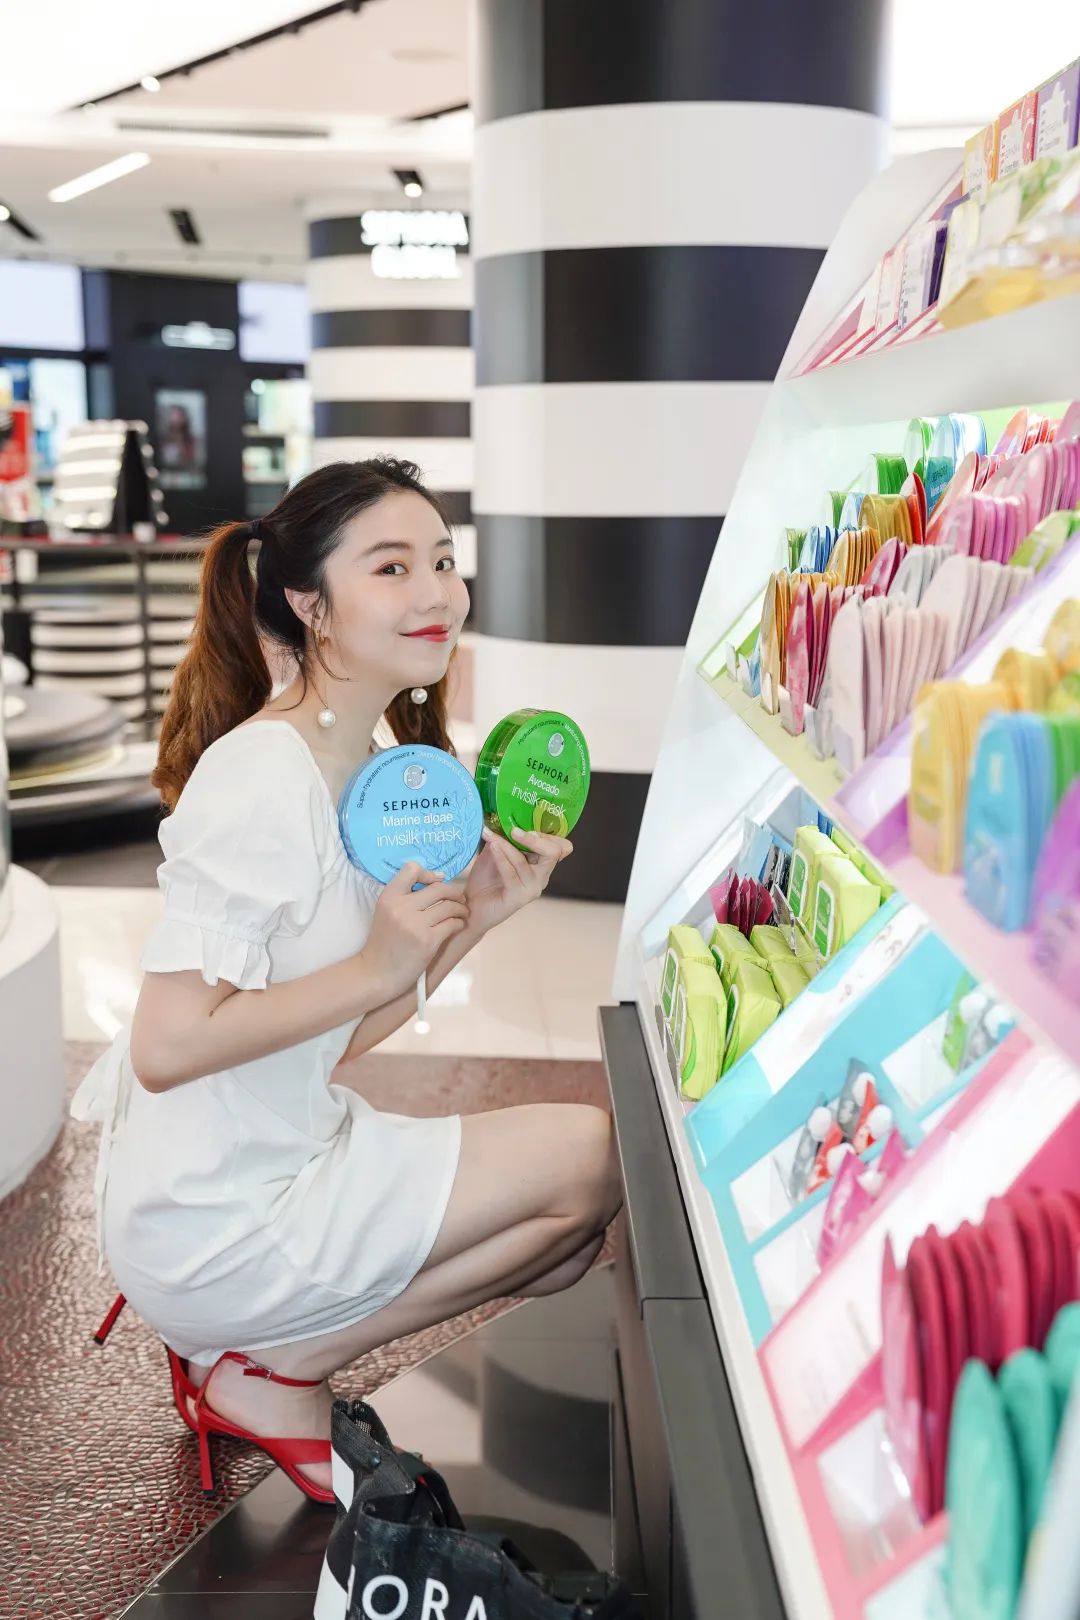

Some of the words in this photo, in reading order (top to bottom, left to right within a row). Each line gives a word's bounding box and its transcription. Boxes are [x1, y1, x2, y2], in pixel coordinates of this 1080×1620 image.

[526, 757, 569, 785] SEPHORA
[528, 774, 560, 796] Avocado
[383, 797, 450, 812] SEPHORA
[511, 782, 540, 806] invisilk
[540, 799, 566, 818] mask
[382, 814, 421, 827] Marine
[423, 812, 454, 826] algae
[376, 829, 420, 848] invisilk
[423, 826, 462, 844] mask
[347, 1564, 488, 1620] ORA
